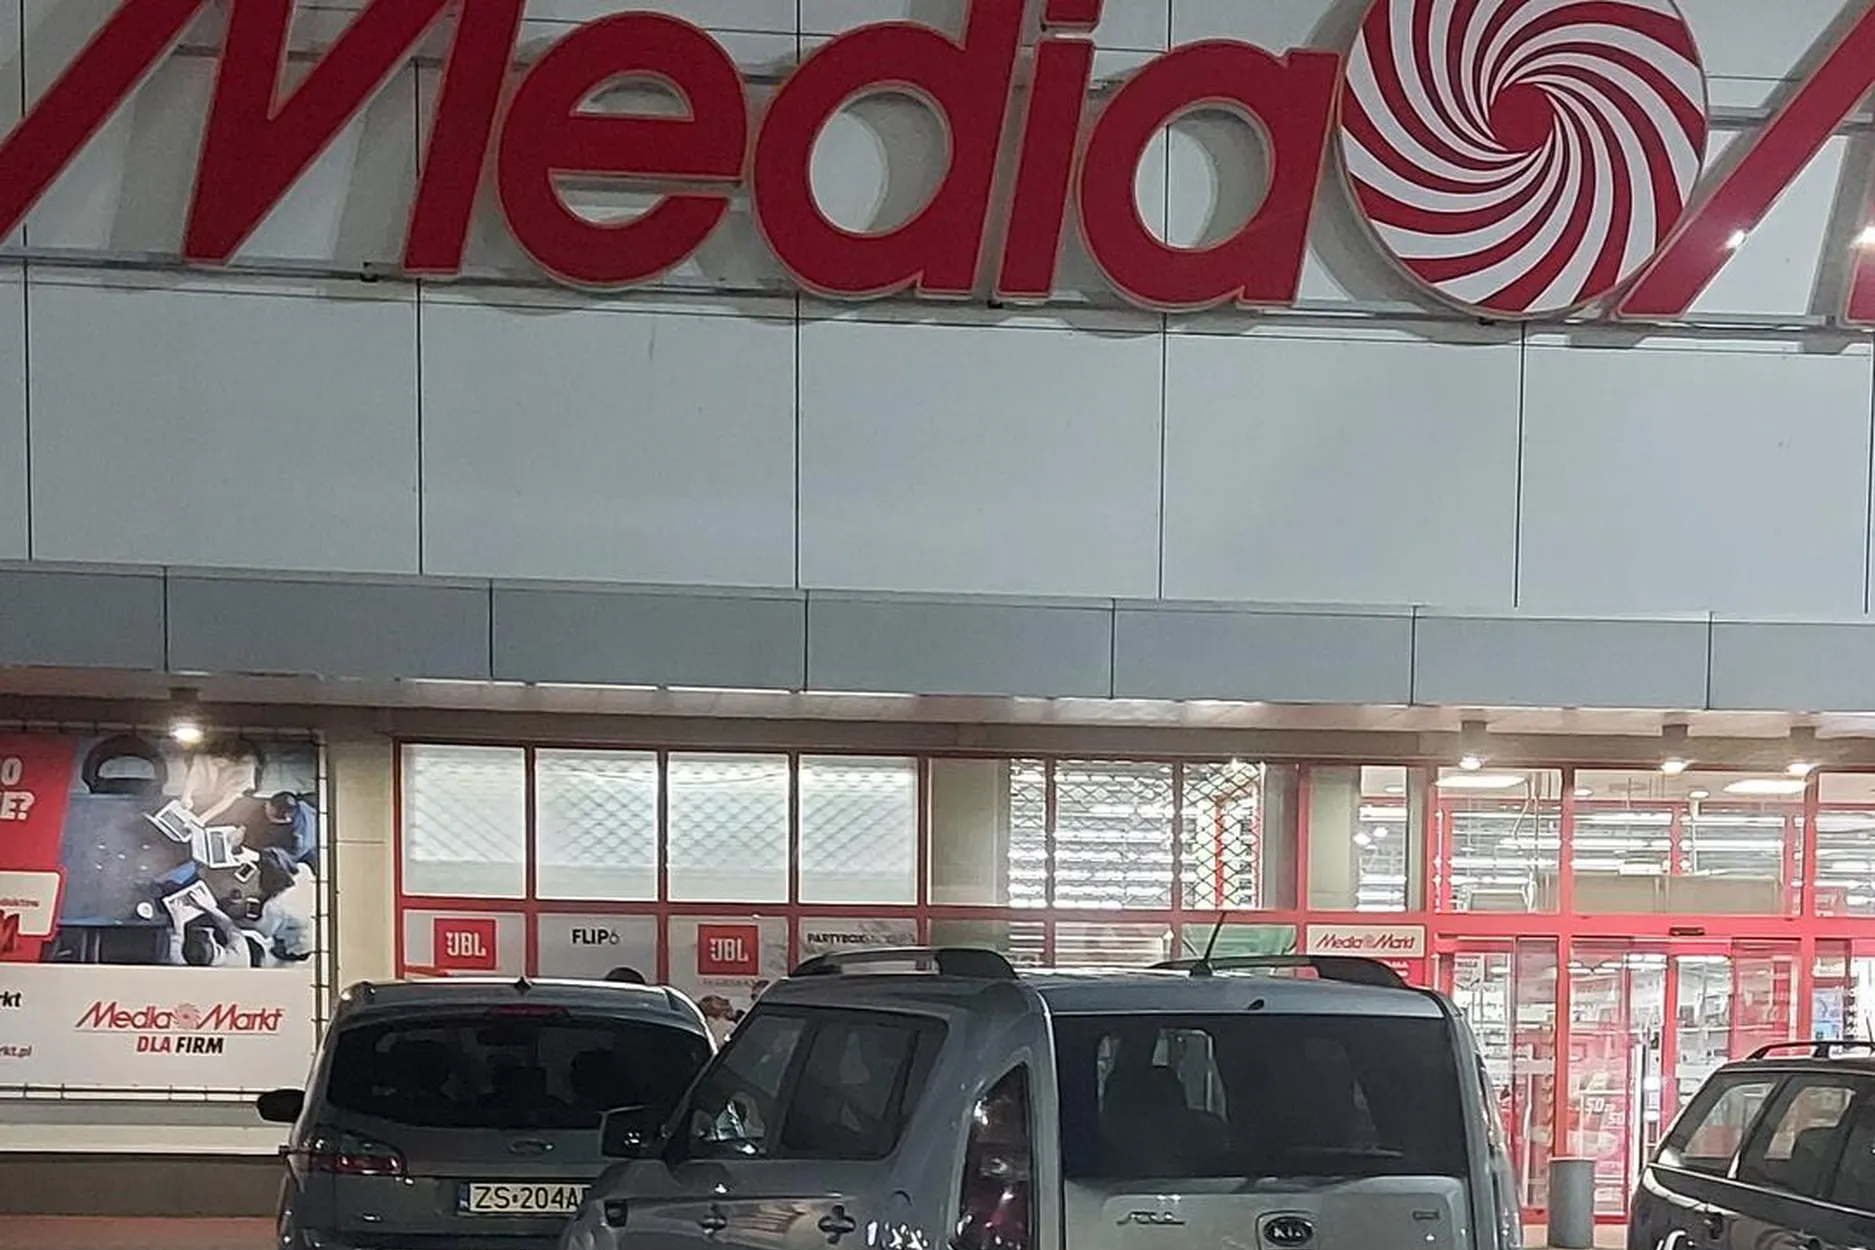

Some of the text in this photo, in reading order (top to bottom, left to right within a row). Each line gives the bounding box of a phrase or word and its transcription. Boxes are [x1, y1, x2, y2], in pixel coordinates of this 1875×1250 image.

[0, 0, 1345, 312] Media
[446, 931, 487, 957] JBL
[710, 937, 749, 962] JBL
[1316, 933, 1362, 949] Media
[75, 1001, 282, 1031] Media Markt
[136, 1036, 224, 1054] DLA FIRM
[474, 1186, 510, 1209] ZS
